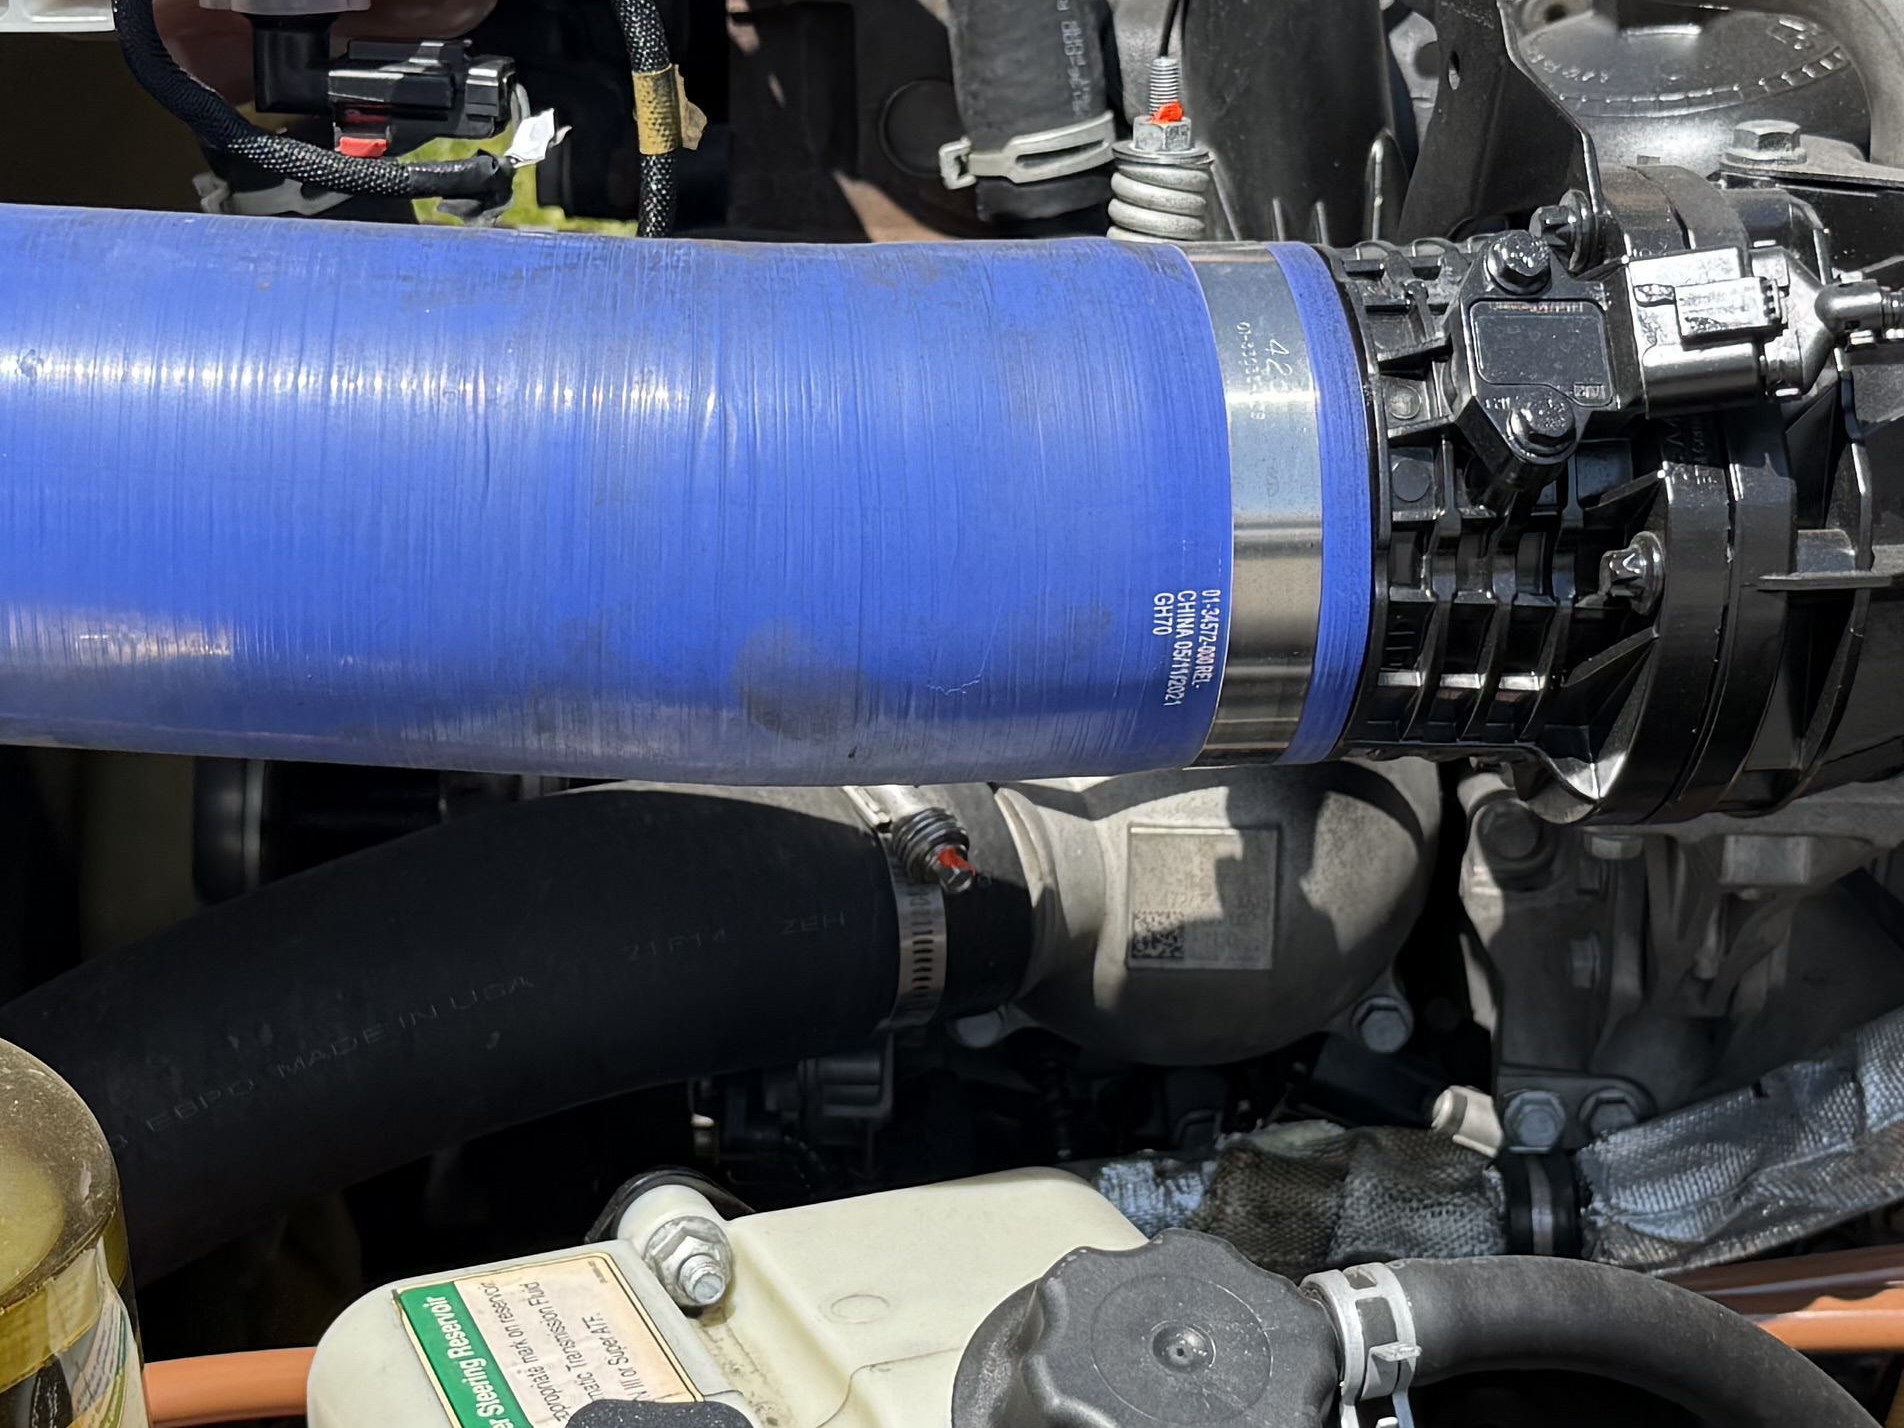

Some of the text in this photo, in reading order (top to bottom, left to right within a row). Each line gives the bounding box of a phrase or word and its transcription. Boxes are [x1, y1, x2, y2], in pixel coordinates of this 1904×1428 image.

[1153, 592, 1174, 636] GH70
[1164, 590, 1197, 707] CHINA 05/11/2021
[275, 975, 535, 1079] MADE IN USA
[426, 1296, 470, 1360] Reservoir
[504, 1321, 523, 1338] on
[517, 1341, 538, 1365] mark
[519, 1281, 584, 1373] Transmission Fluid
[600, 1337, 629, 1367] Super
[459, 1357, 504, 1417] Steering
